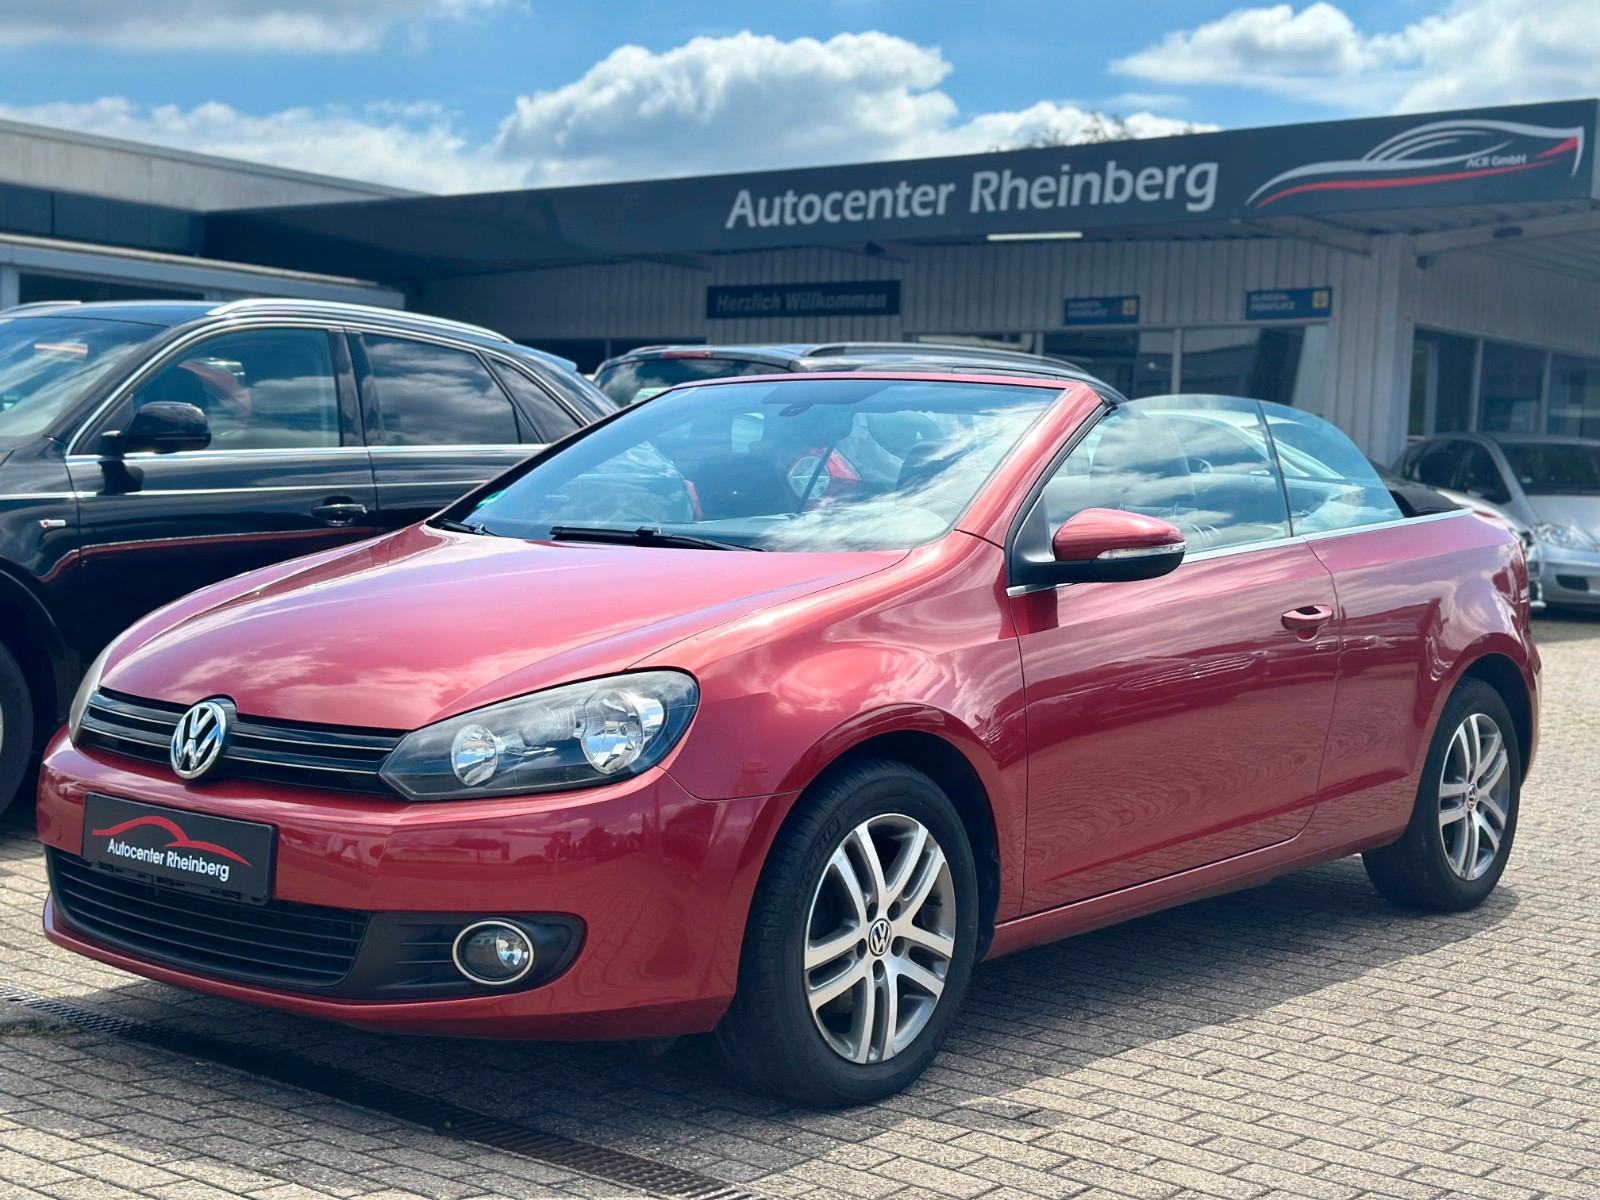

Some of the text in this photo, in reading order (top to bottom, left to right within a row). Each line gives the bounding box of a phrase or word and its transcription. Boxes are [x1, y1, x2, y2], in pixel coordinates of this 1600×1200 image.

[1491, 153, 1527, 167] GmbH
[725, 160, 1220, 229] Autocenter Rheinberg
[716, 290, 888, 312] Herzlich Willkommen
[107, 838, 230, 882] Autocenter Rheinberg
